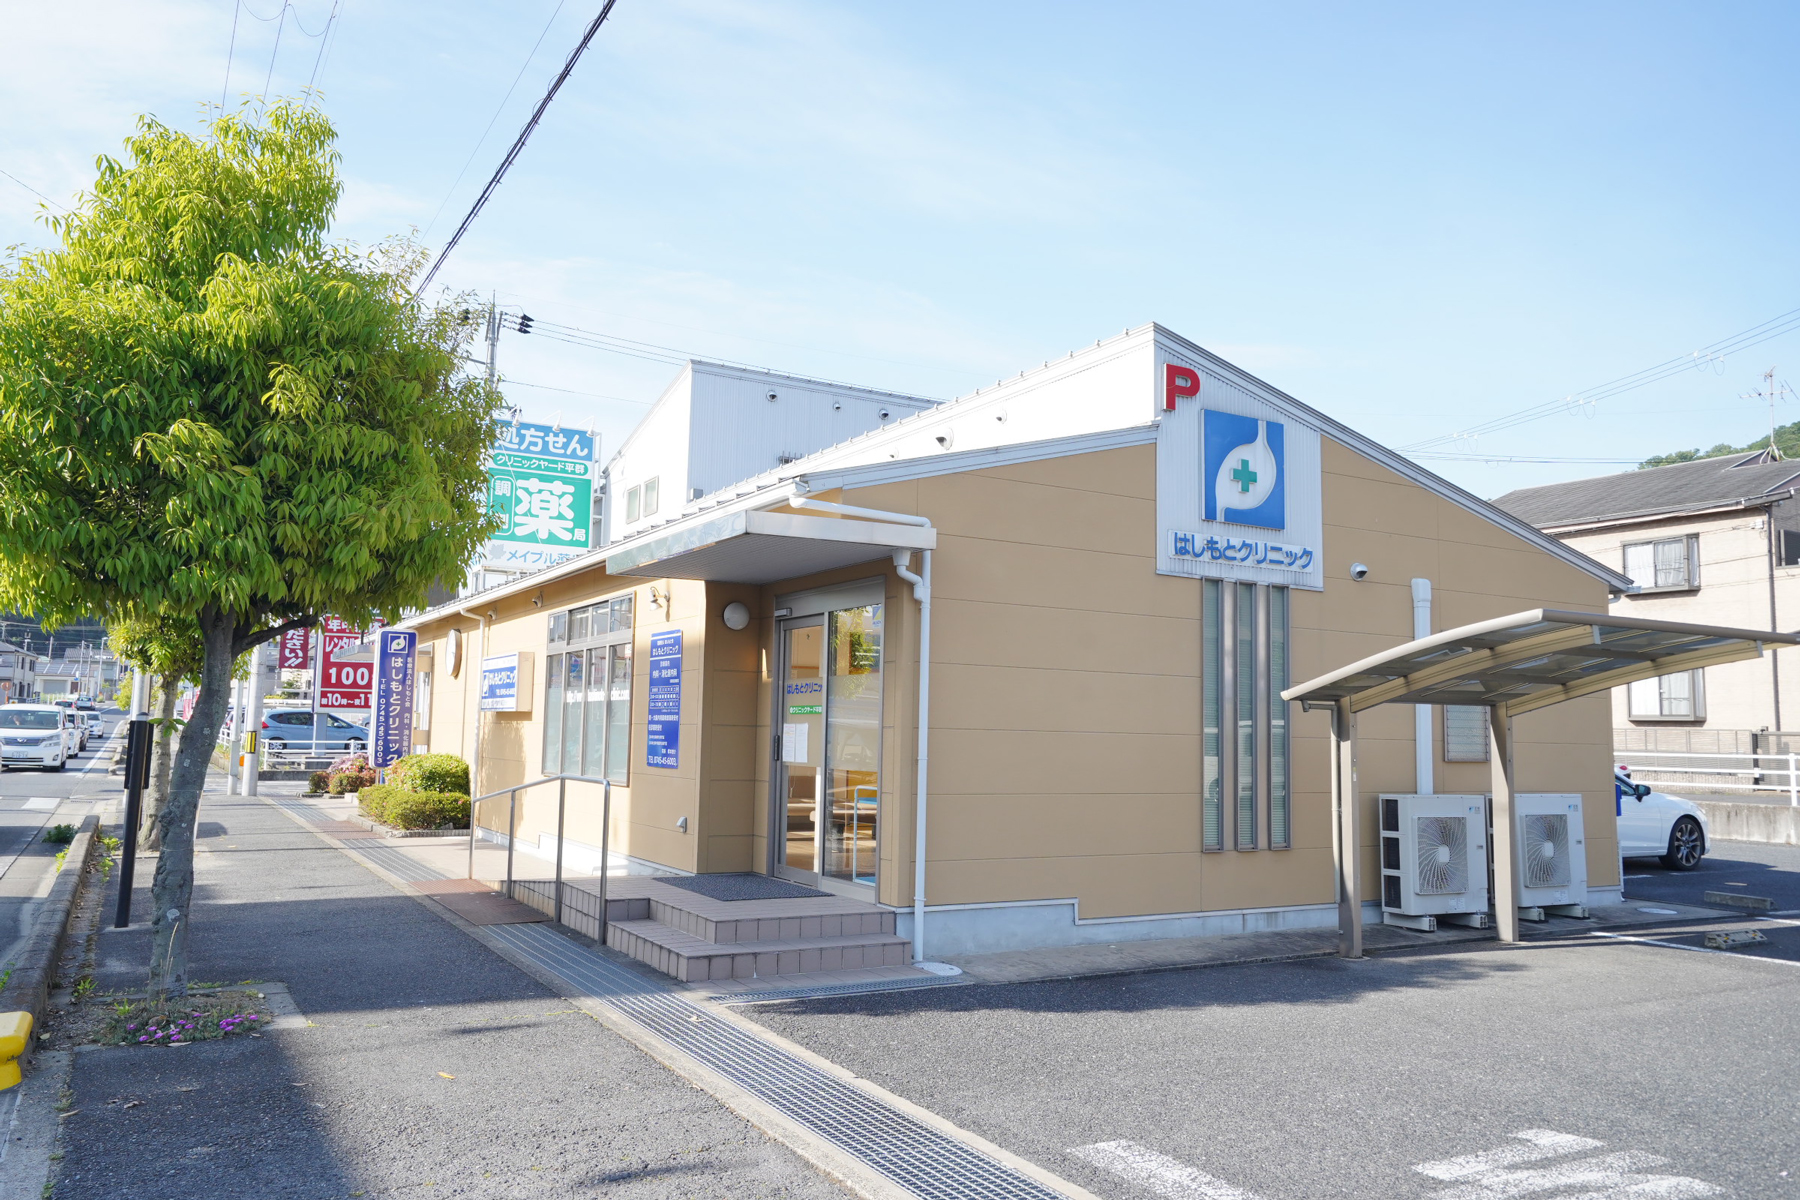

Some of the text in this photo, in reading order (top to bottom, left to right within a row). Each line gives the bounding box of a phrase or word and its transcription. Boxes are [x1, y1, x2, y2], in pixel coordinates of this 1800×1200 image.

[1165, 363, 1200, 410] P
[495, 426, 589, 457] 処方せん
[496, 454, 586, 474] クリニックヤード平群
[506, 549, 576, 565] メイプル薬
[1174, 531, 1313, 570] はしもとクリニック
[386, 656, 404, 765] はしもとクリニック
